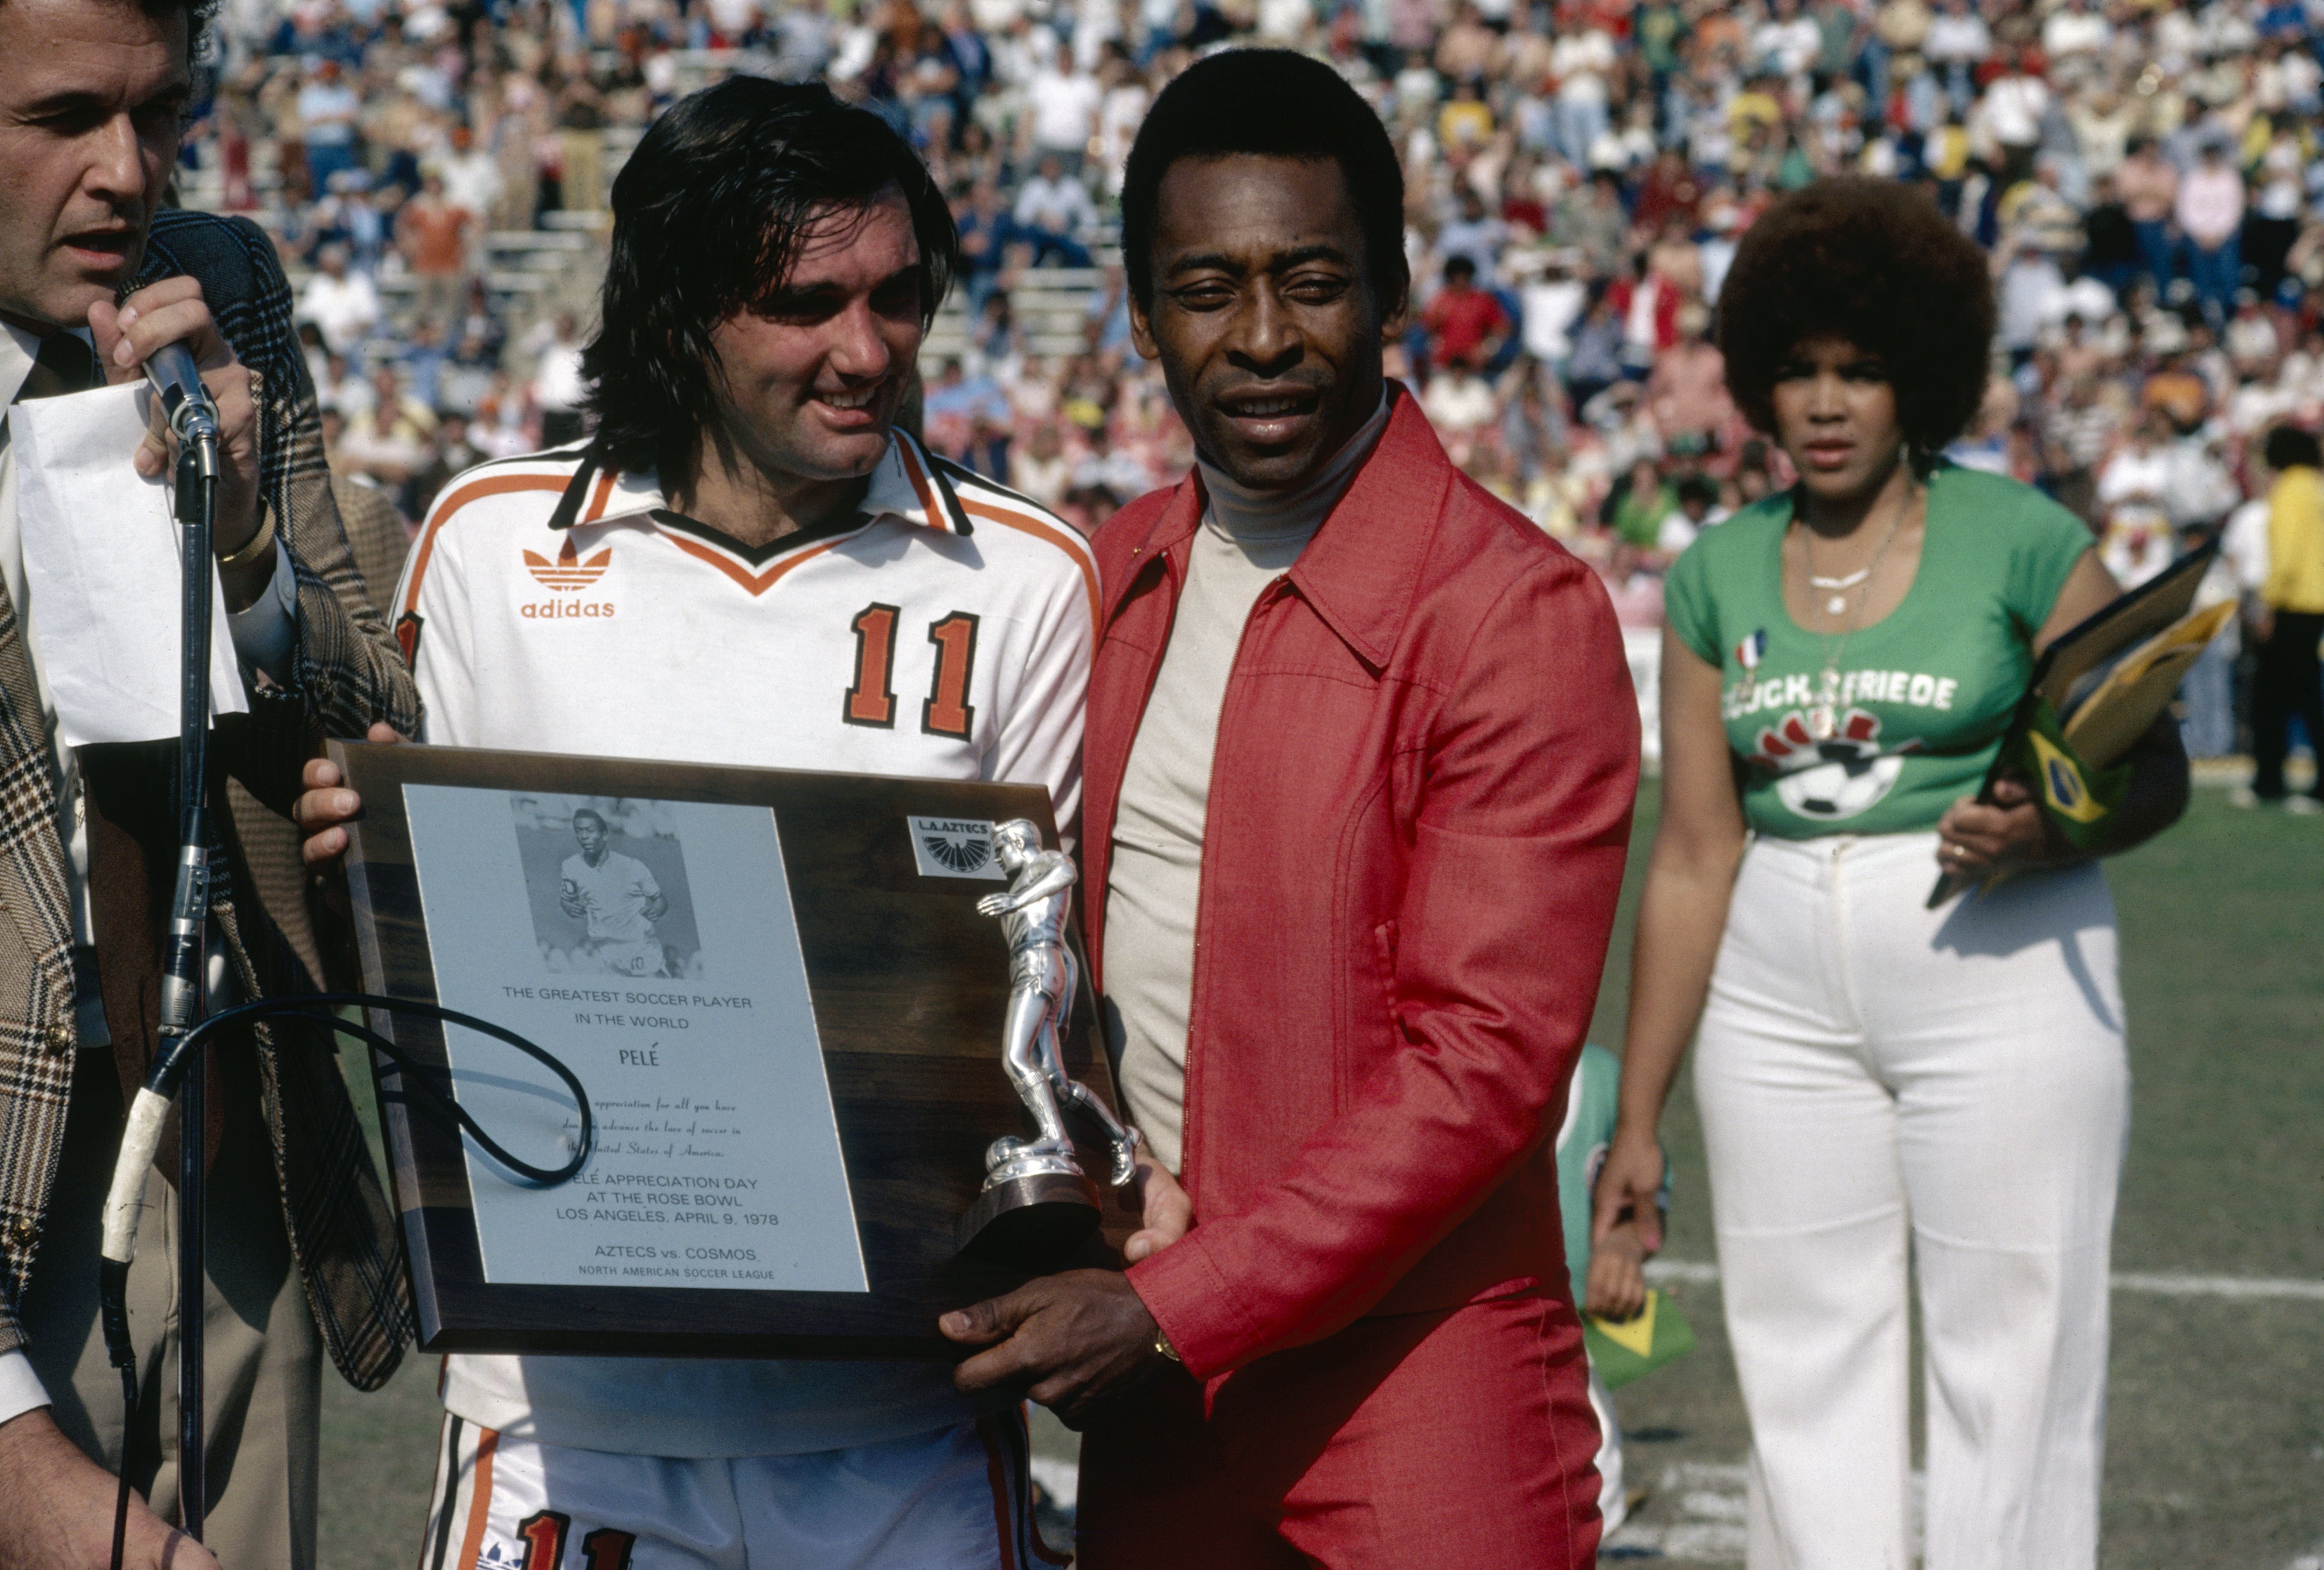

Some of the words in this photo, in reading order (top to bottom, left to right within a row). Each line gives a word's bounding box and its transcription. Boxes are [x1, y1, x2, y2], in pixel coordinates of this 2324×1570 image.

[521, 599, 615, 618] adidas
[842, 601, 981, 742] 11
[1841, 669, 1959, 711] FRIEDE
[502, 986, 535, 999] THE
[538, 988, 621, 1003] GREATEST
[625, 992, 689, 1006] SOCCER
[692, 995, 753, 1009] PLAYER
[575, 1013, 591, 1025] IN
[594, 1014, 626, 1026] THE
[629, 1016, 689, 1029] WORLD
[618, 1041, 659, 1067] PELÉ
[594, 1099, 651, 1110] appreciation
[656, 1097, 670, 1112] for
[675, 1097, 690, 1110] all
[694, 1105, 710, 1113] you
[715, 1099, 736, 1111] have
[602, 1120, 640, 1131] advance
[644, 1120, 659, 1132] the
[664, 1120, 682, 1133] love
[686, 1121, 696, 1136] of
[626, 1142, 659, 1154] States
[663, 1143, 674, 1158] of
[678, 1144, 724, 1157] America.
[573, 1168, 600, 1185] ELÉ
[605, 1174, 720, 1189] APPRECIATION
[723, 1178, 758, 1190] DAY
[586, 1191, 607, 1203] AT
[611, 1192, 643, 1204] THE
[646, 1193, 690, 1206] ROSE
[694, 1194, 743, 1207] BOWL
[556, 1208, 589, 1221] LOS
[673, 1212, 719, 1225] APRIL
[743, 1213, 779, 1226] 1978
[594, 1245, 657, 1258] AZTECS
[685, 1247, 757, 1261] COSMOS
[578, 1265, 617, 1275] NORTH
[622, 1267, 680, 1277] AMERICAN
[683, 1268, 728, 1278] SOCCER
[732, 1270, 774, 1280] LEAGUE
